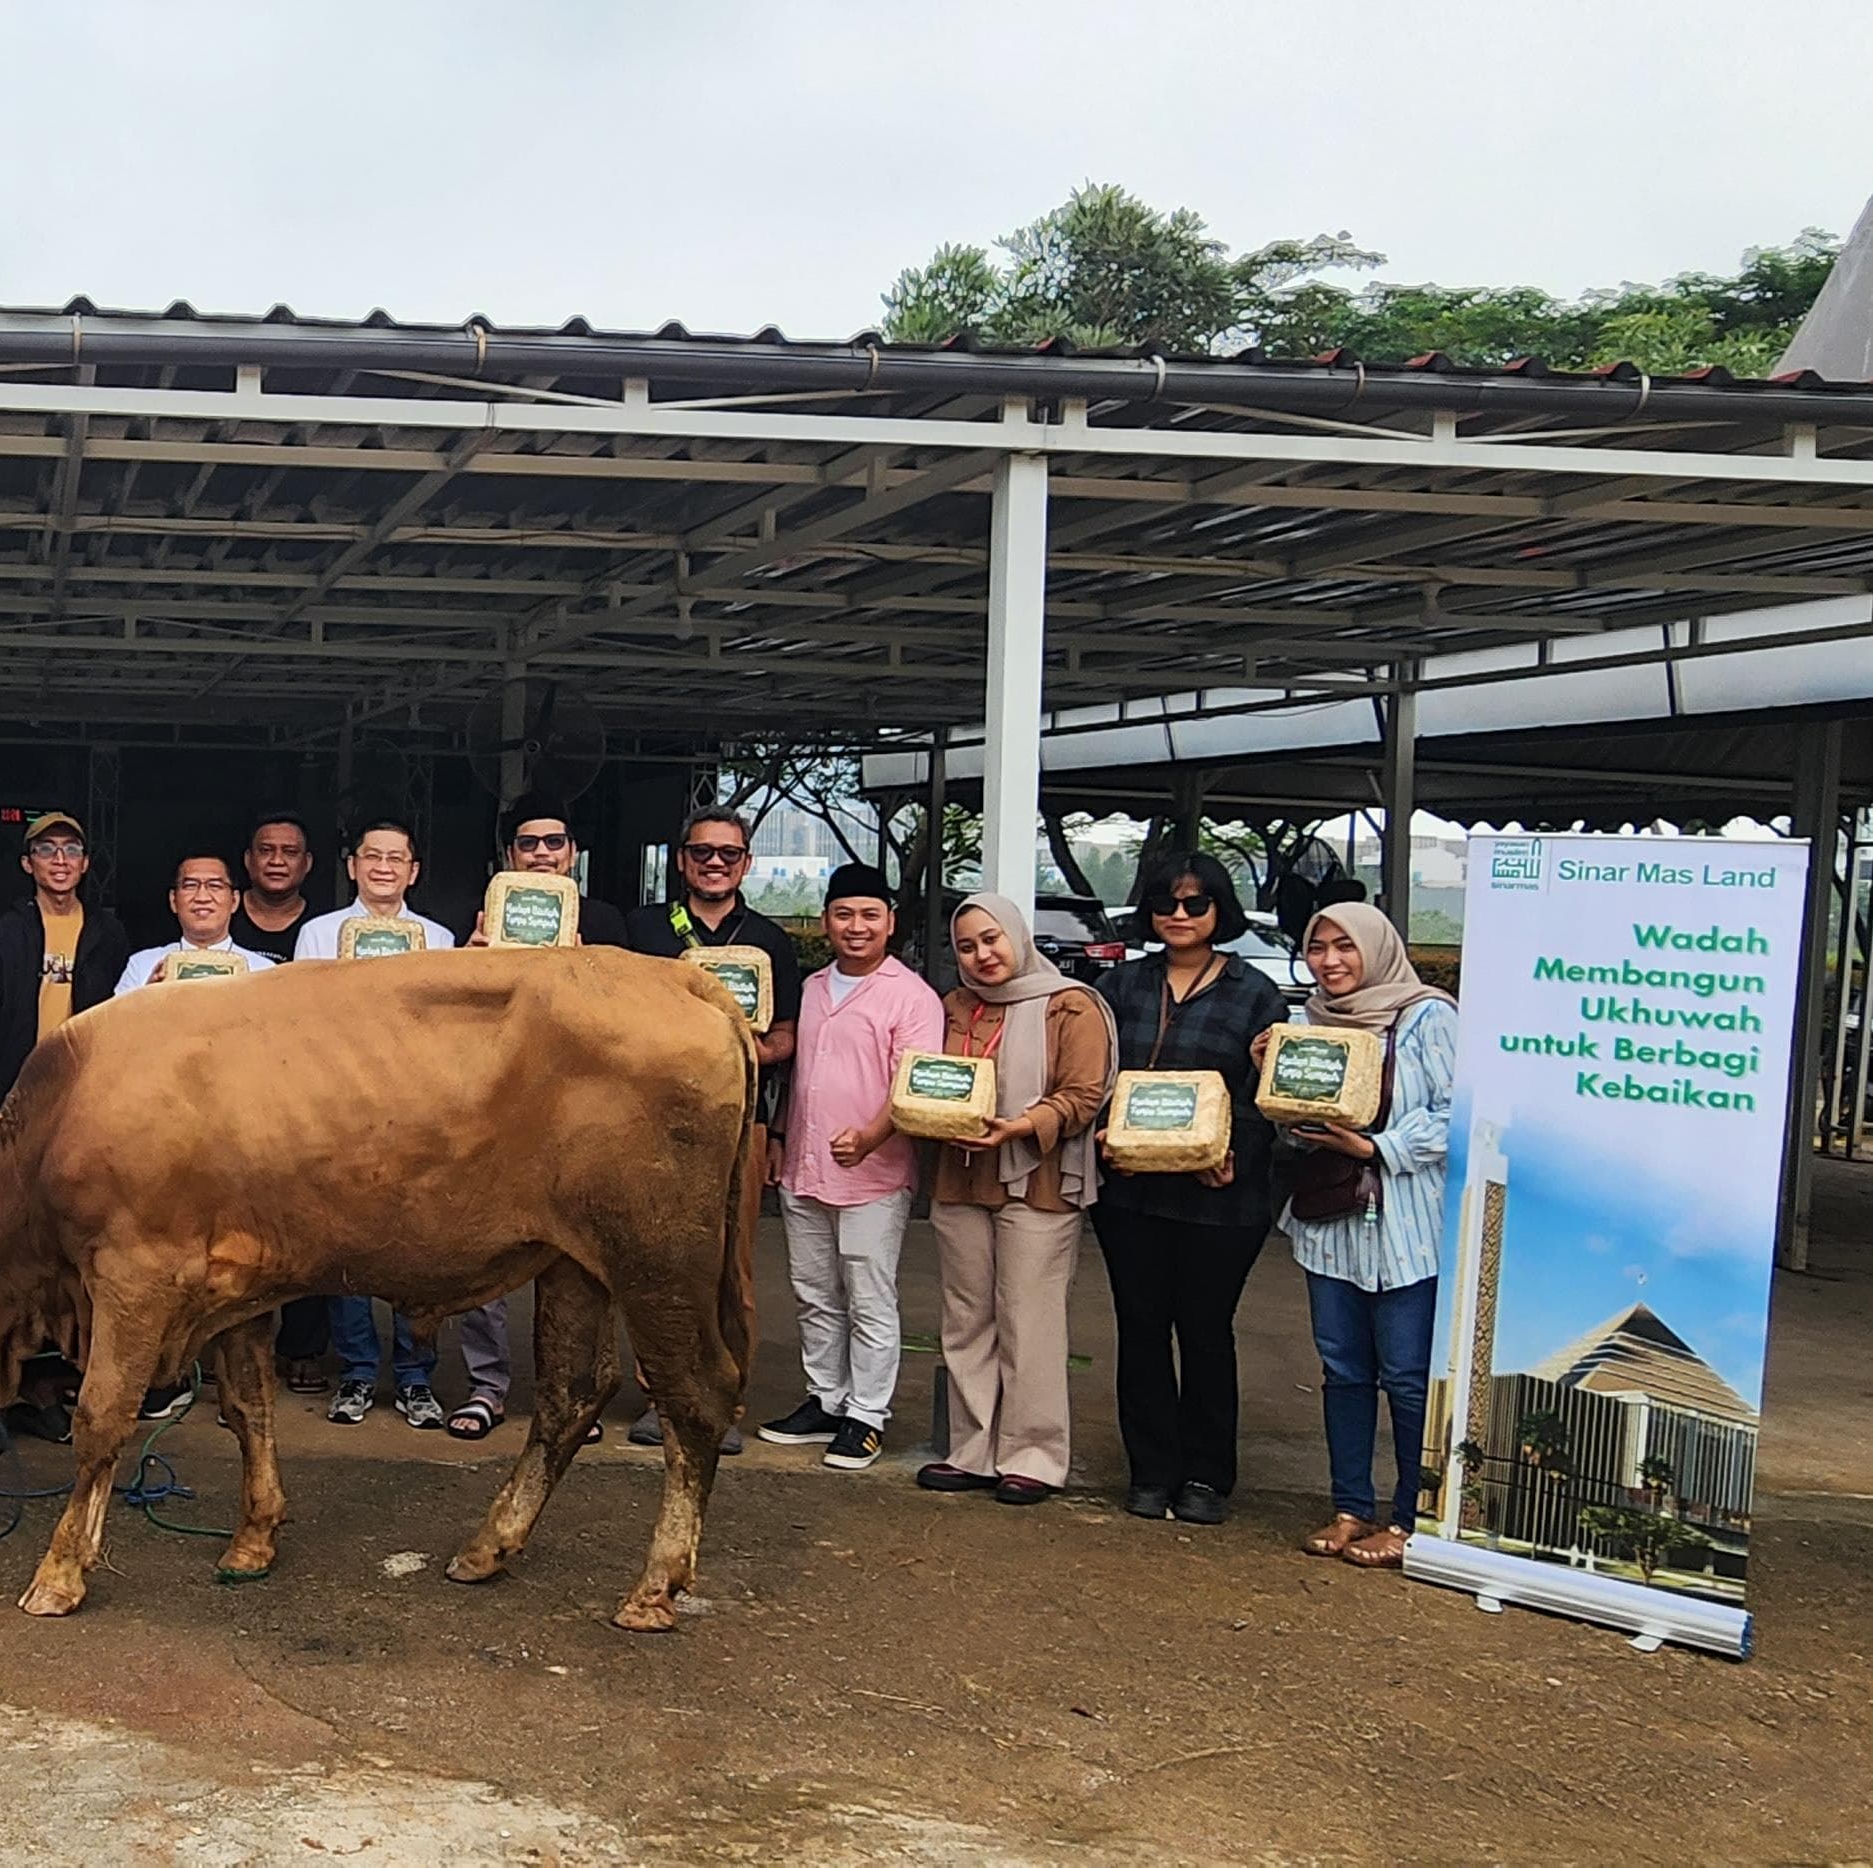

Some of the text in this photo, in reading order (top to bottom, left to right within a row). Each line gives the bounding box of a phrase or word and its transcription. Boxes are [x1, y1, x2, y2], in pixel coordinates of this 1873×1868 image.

[1558, 860, 1630, 882] Sinar
[1636, 863, 1693, 884] Mas
[1703, 865, 1776, 888] Land
[1633, 923, 1769, 955] Wadah
[1533, 957, 1765, 997] Membangun
[1581, 997, 1762, 1033] Ukhuwah
[1500, 1033, 1759, 1077] untuk Berbagi
[1576, 1072, 1755, 1112] Kebaikan
